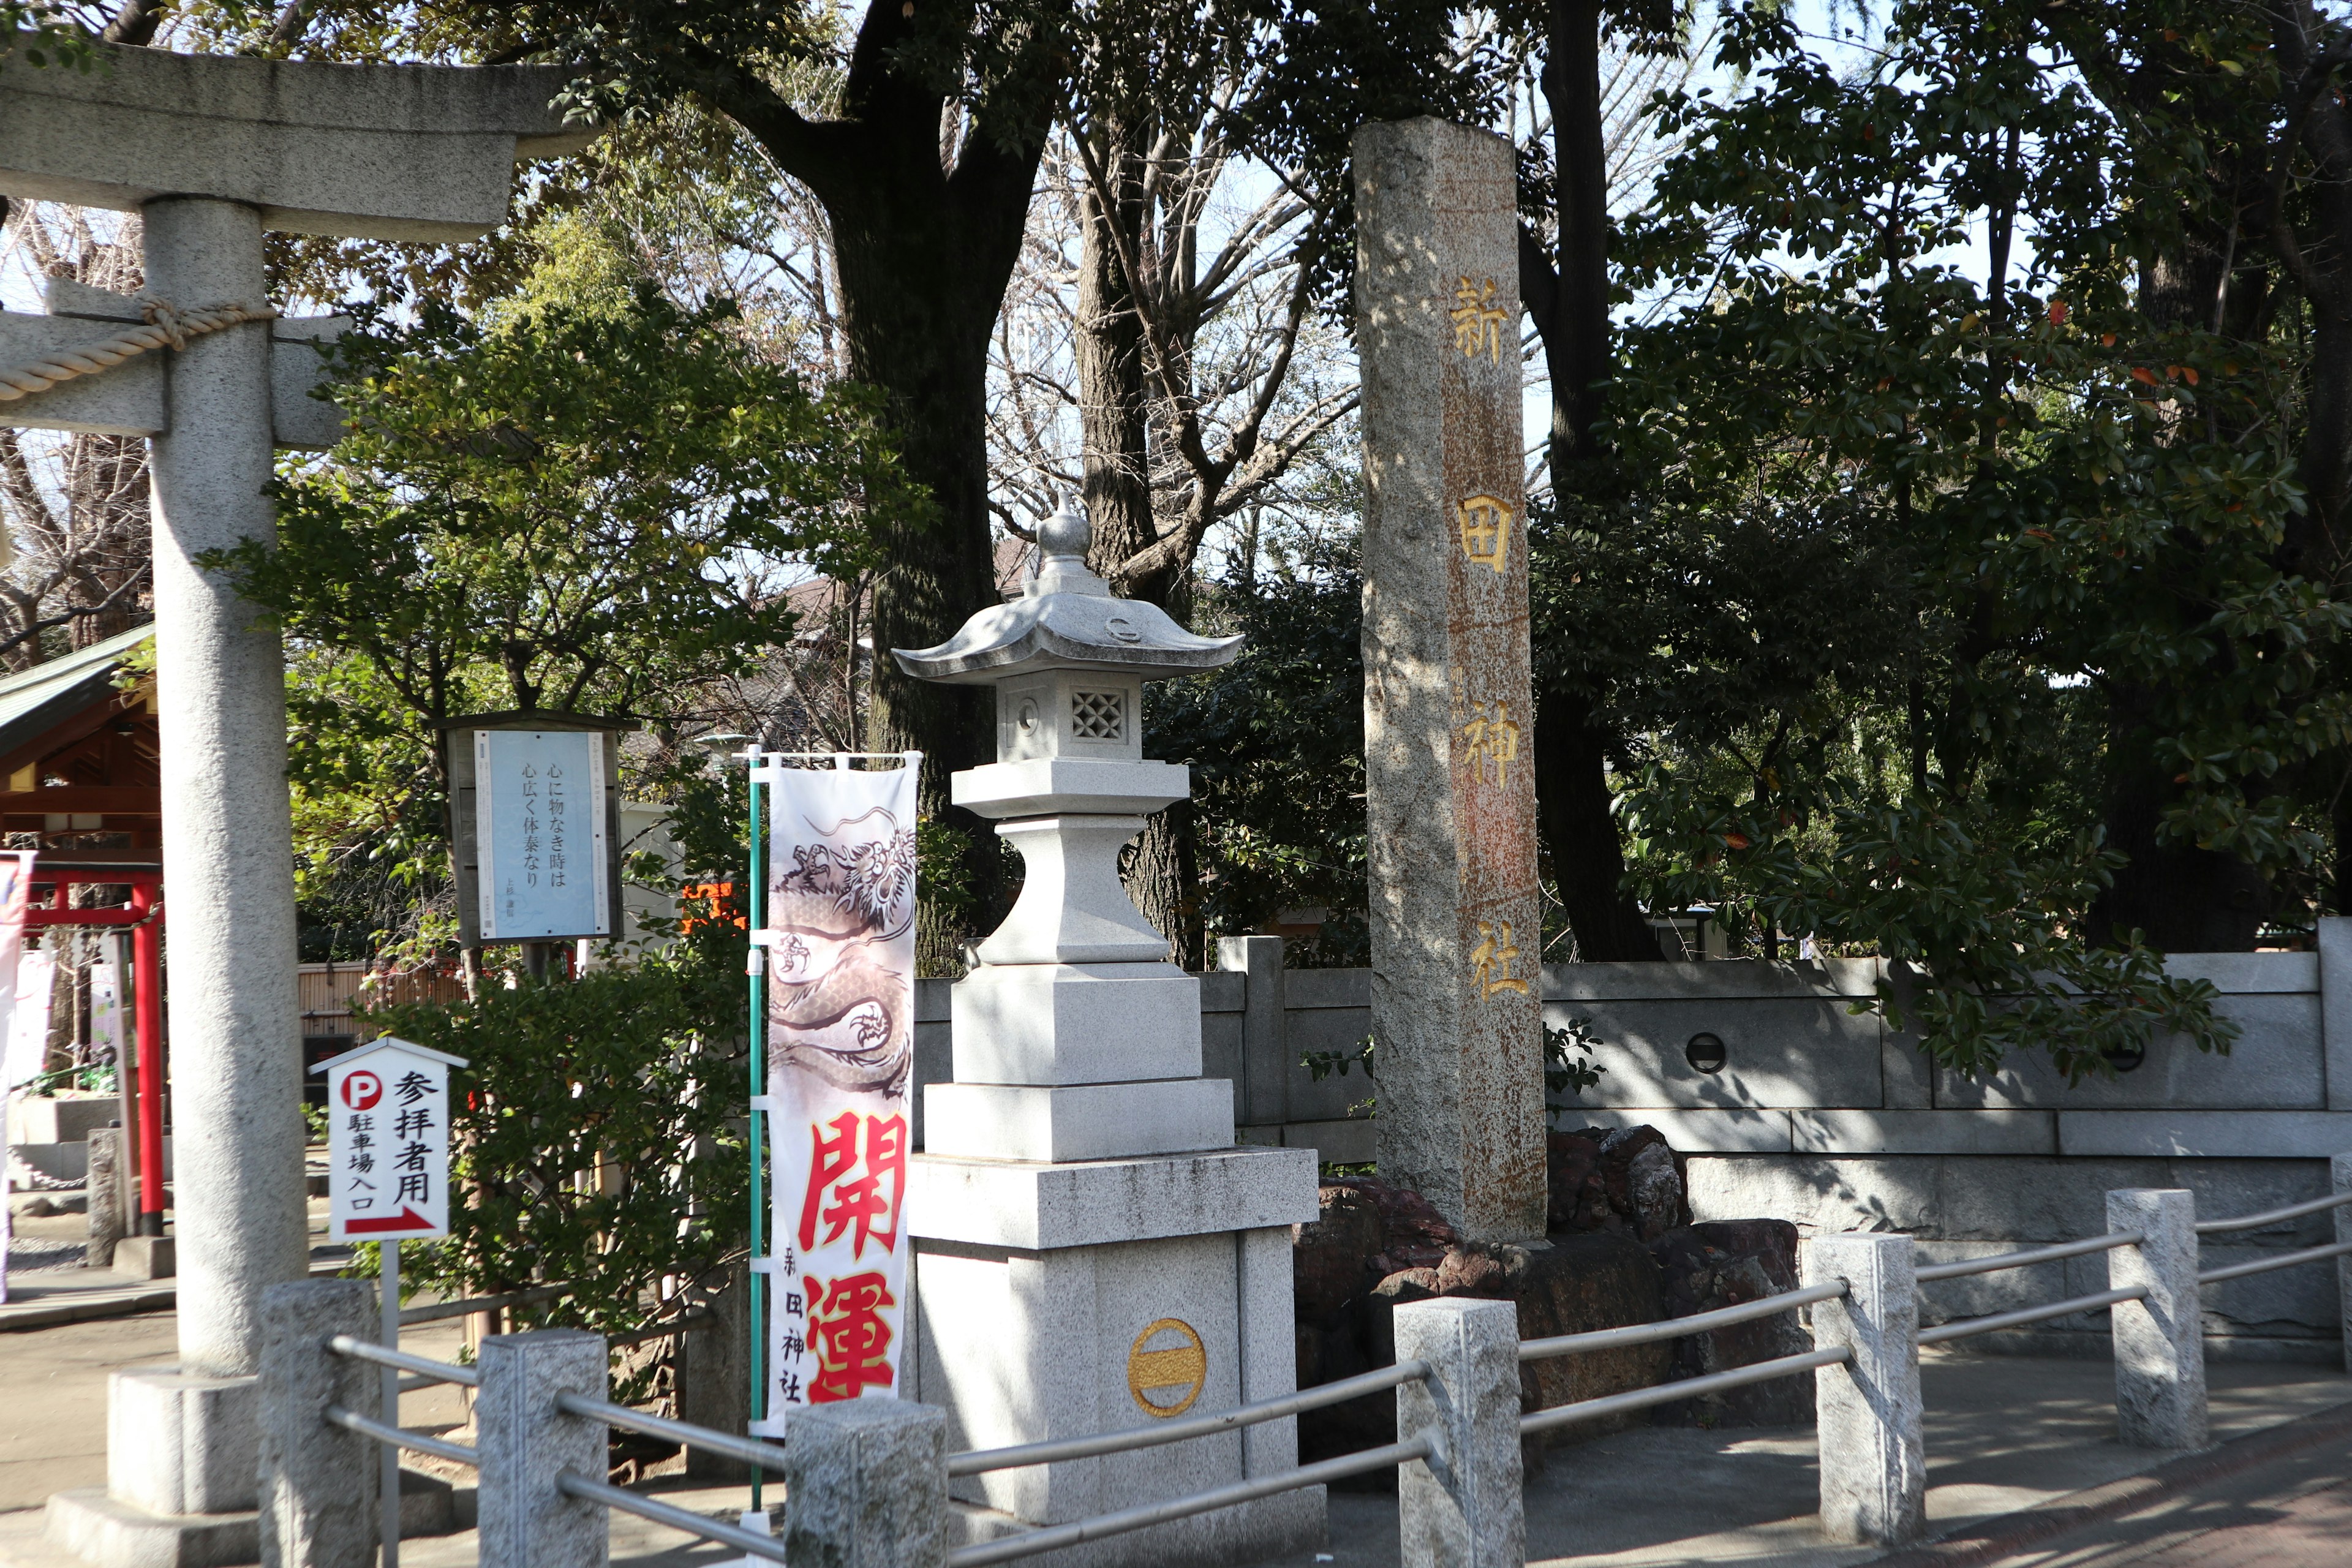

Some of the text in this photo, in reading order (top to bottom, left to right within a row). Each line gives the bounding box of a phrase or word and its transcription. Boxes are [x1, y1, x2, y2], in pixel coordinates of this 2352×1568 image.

[1449, 275, 1530, 1003] 新田神社
[521, 763, 539, 888] 心広く体泰なり
[547, 763, 566, 888] 心に物なき時は
[347, 1114, 377, 1210] 駐車場入口
[393, 1071, 439, 1205] 参拝者用
[797, 1111, 907, 1405] 開運
[778, 1247, 804, 1404] 新田神社
